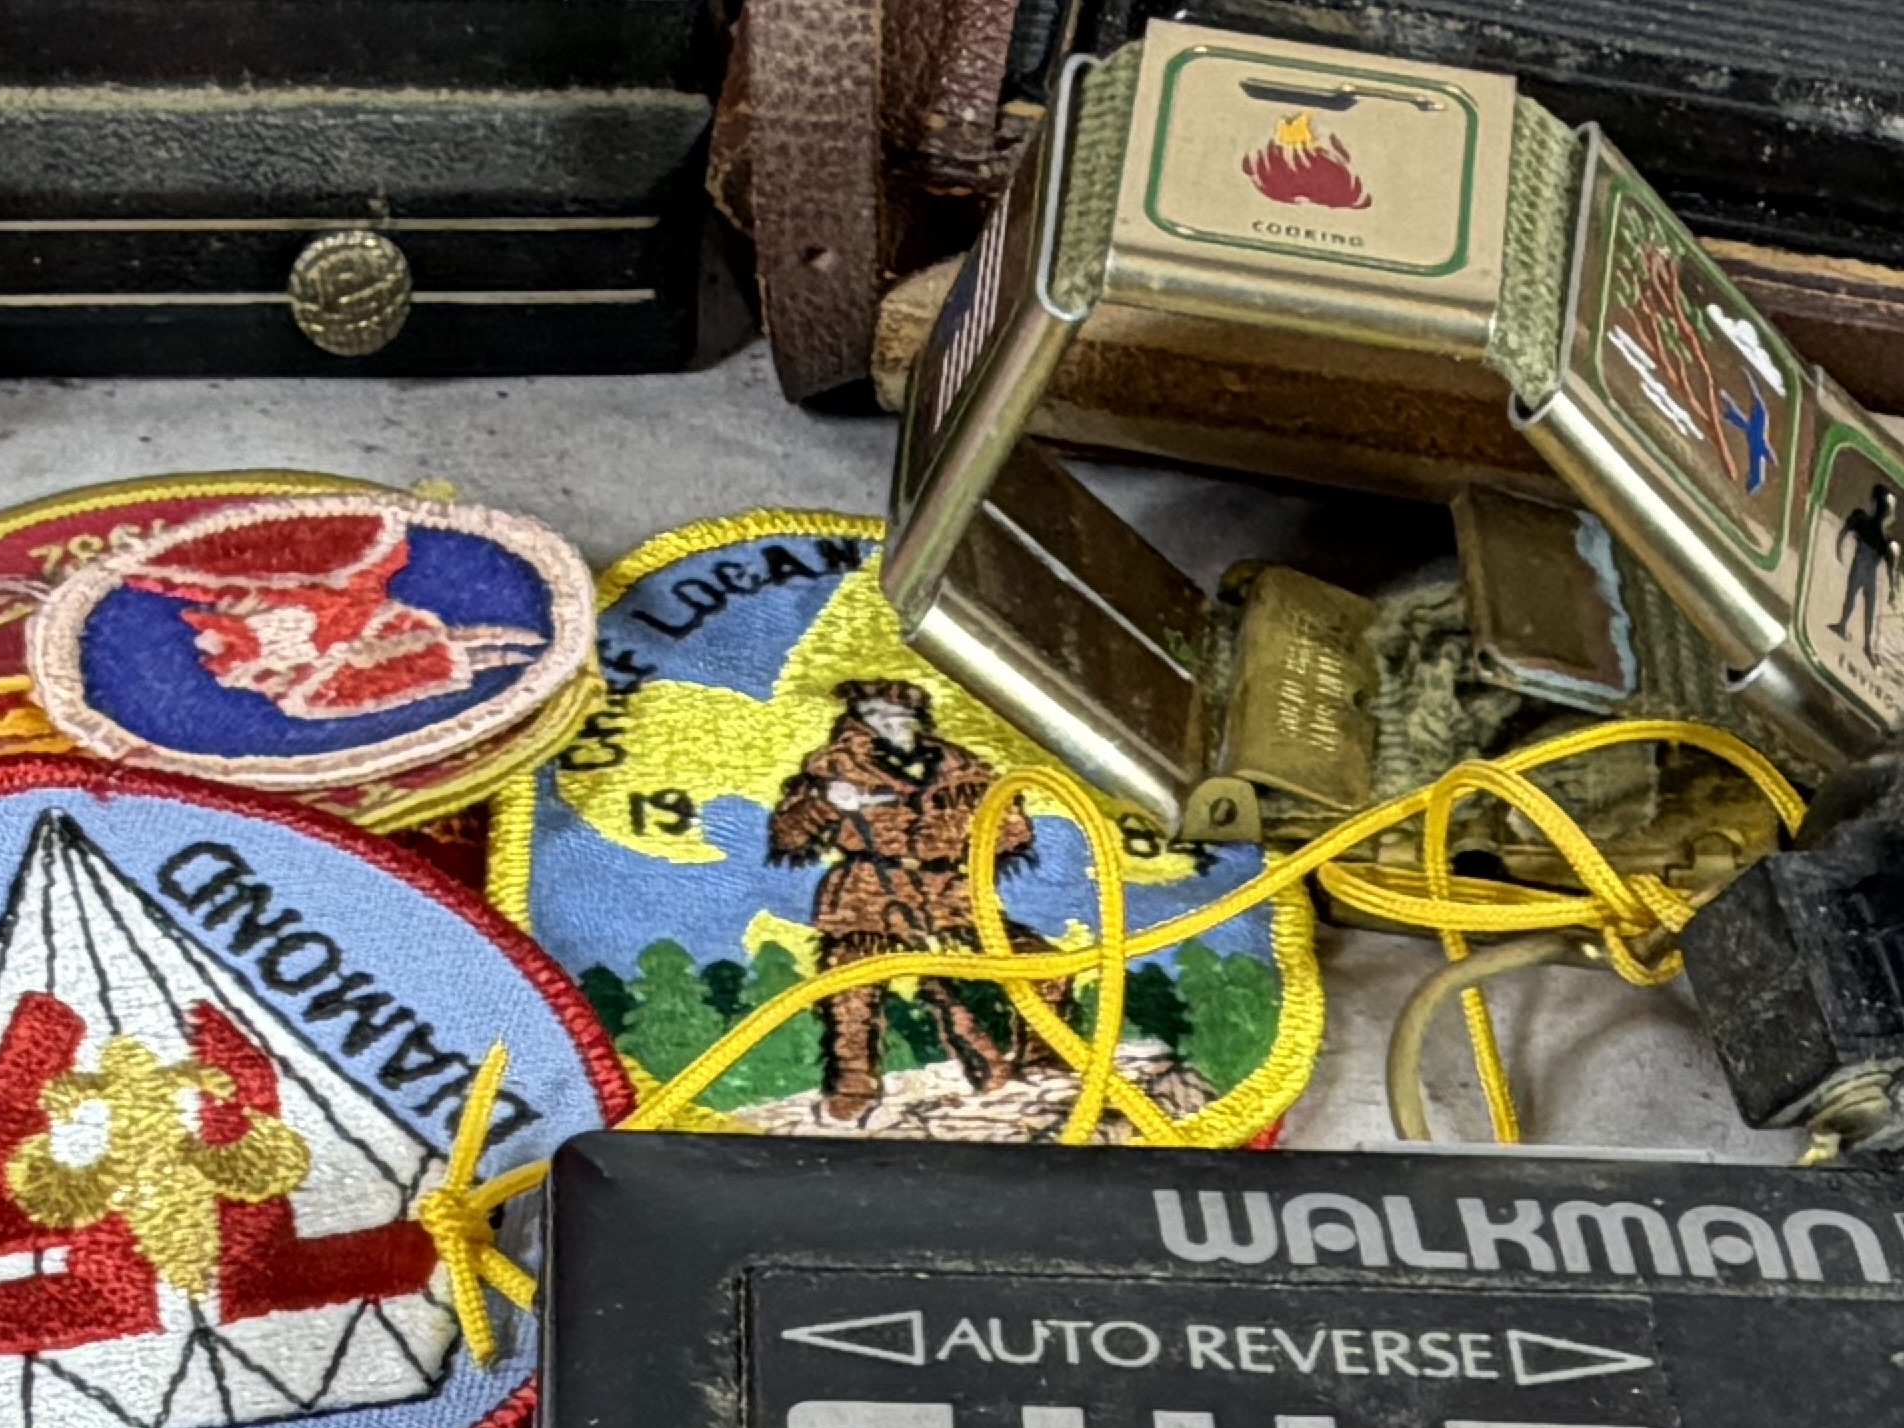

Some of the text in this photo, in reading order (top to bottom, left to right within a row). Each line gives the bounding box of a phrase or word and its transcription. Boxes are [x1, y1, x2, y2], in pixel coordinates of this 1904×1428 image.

[1250, 218, 1365, 248] COOKING
[556, 535, 864, 774] CHIEF LOGAN
[627, 785, 698, 839] 19
[1152, 1186, 1892, 1284] WALKMAN
[936, 1316, 1500, 1380] AUTO REVERSE
